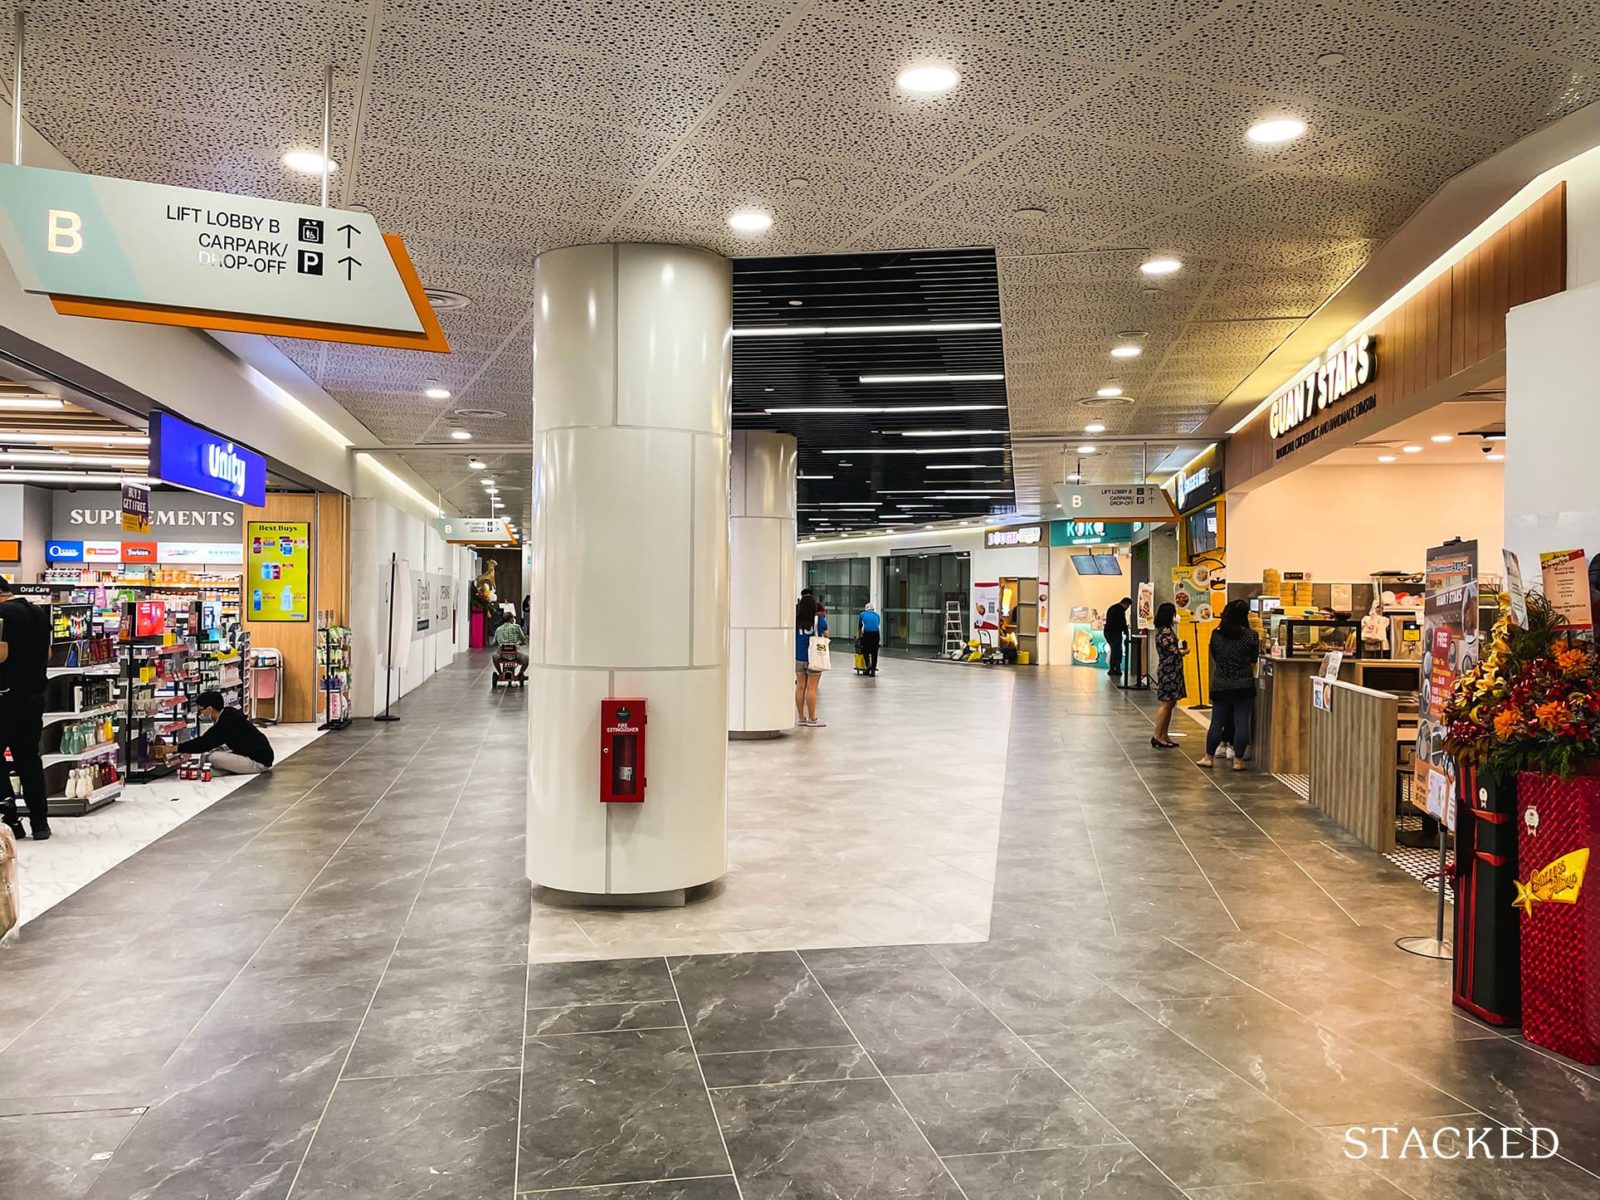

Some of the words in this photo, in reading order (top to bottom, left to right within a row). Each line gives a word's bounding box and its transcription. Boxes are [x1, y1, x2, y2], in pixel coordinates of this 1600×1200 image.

[166, 204, 202, 223] LIFT
[206, 210, 265, 232] LOBBY
[269, 218, 281, 234] B
[47, 208, 84, 254] B
[198, 232, 289, 258] CARPARK/
[1269, 380, 1306, 439] GUAN
[1317, 334, 1371, 410] STARS
[208, 442, 246, 498] Unity
[128, 487, 137, 499] BUY
[1072, 494, 1082, 508] B
[123, 498, 132, 510] GET
[134, 501, 147, 513] FREE
[69, 509, 235, 527] SUPPEMENTS
[258, 524, 277, 532] Best
[278, 524, 298, 533] Buys
